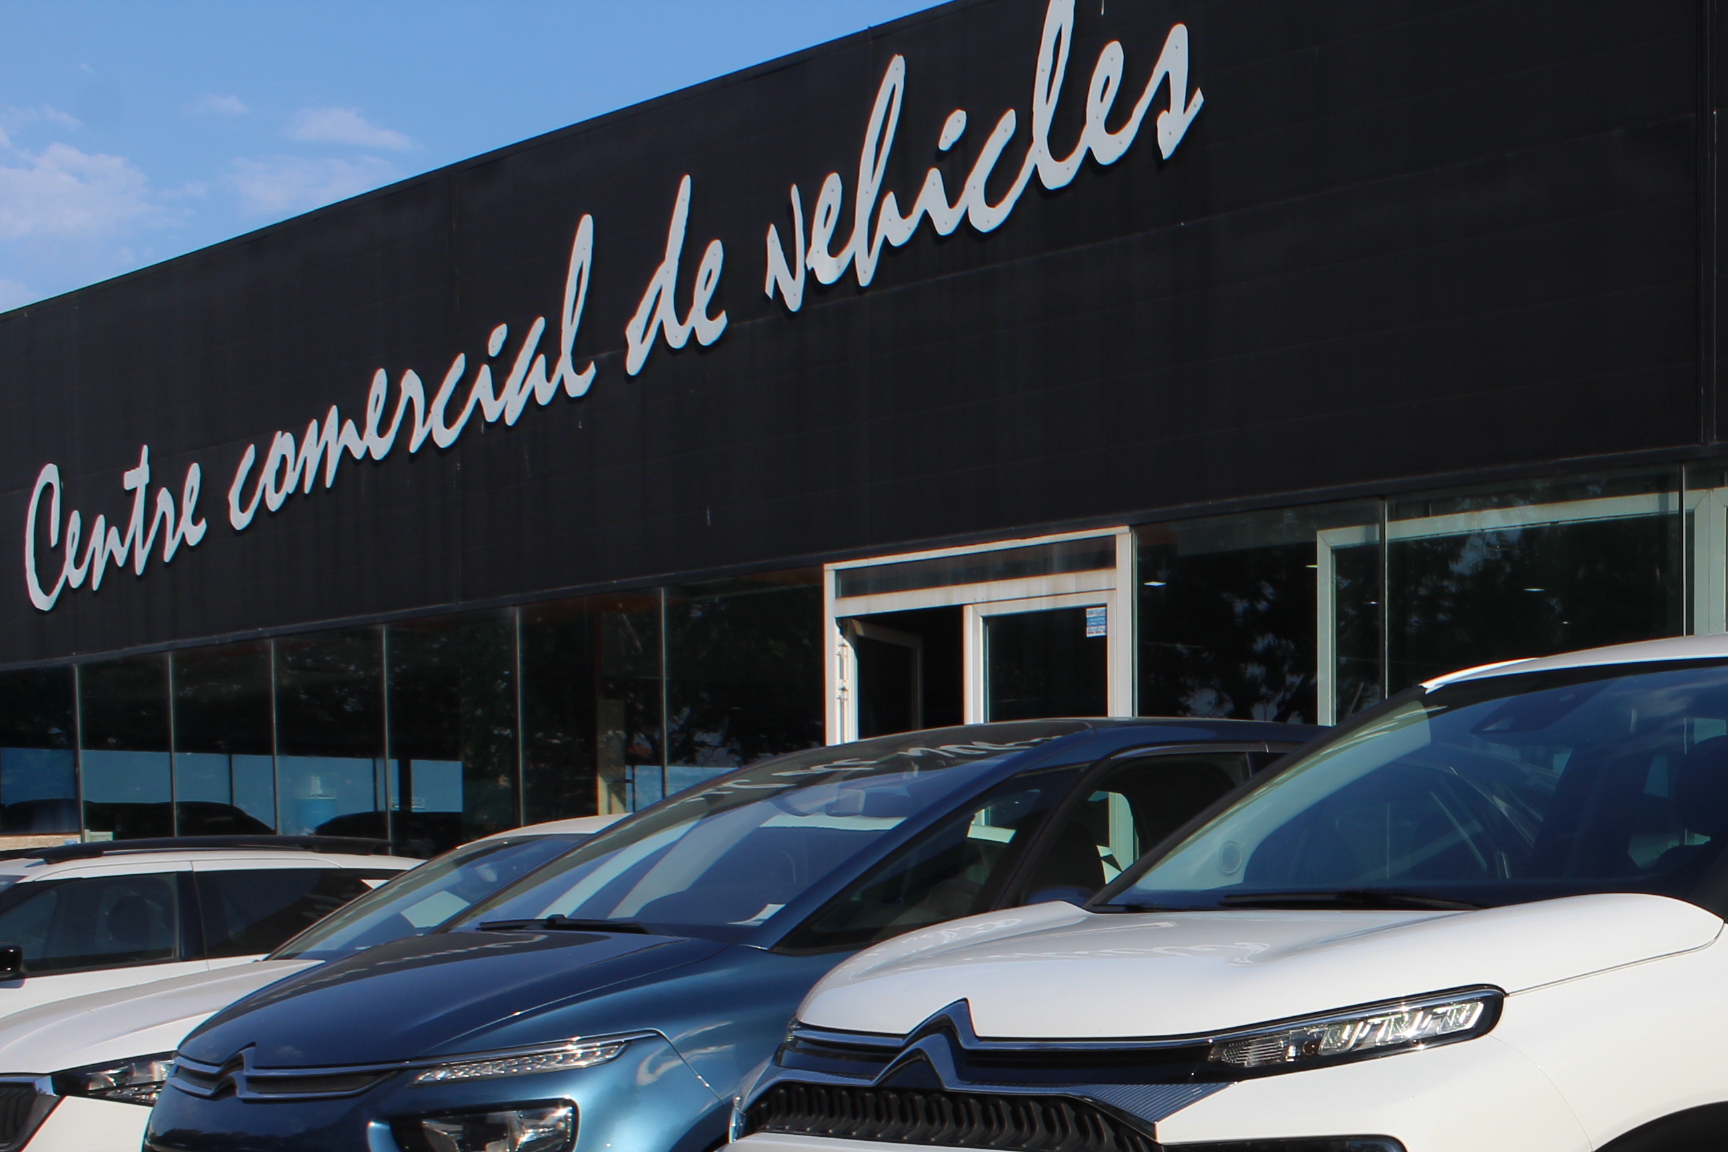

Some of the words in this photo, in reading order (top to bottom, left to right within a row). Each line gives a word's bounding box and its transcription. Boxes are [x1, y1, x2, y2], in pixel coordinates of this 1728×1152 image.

[25, 444, 207, 612] Centre
[228, 213, 597, 531] comercial
[626, 174, 728, 376] de
[764, 0, 1205, 312] vehicles
